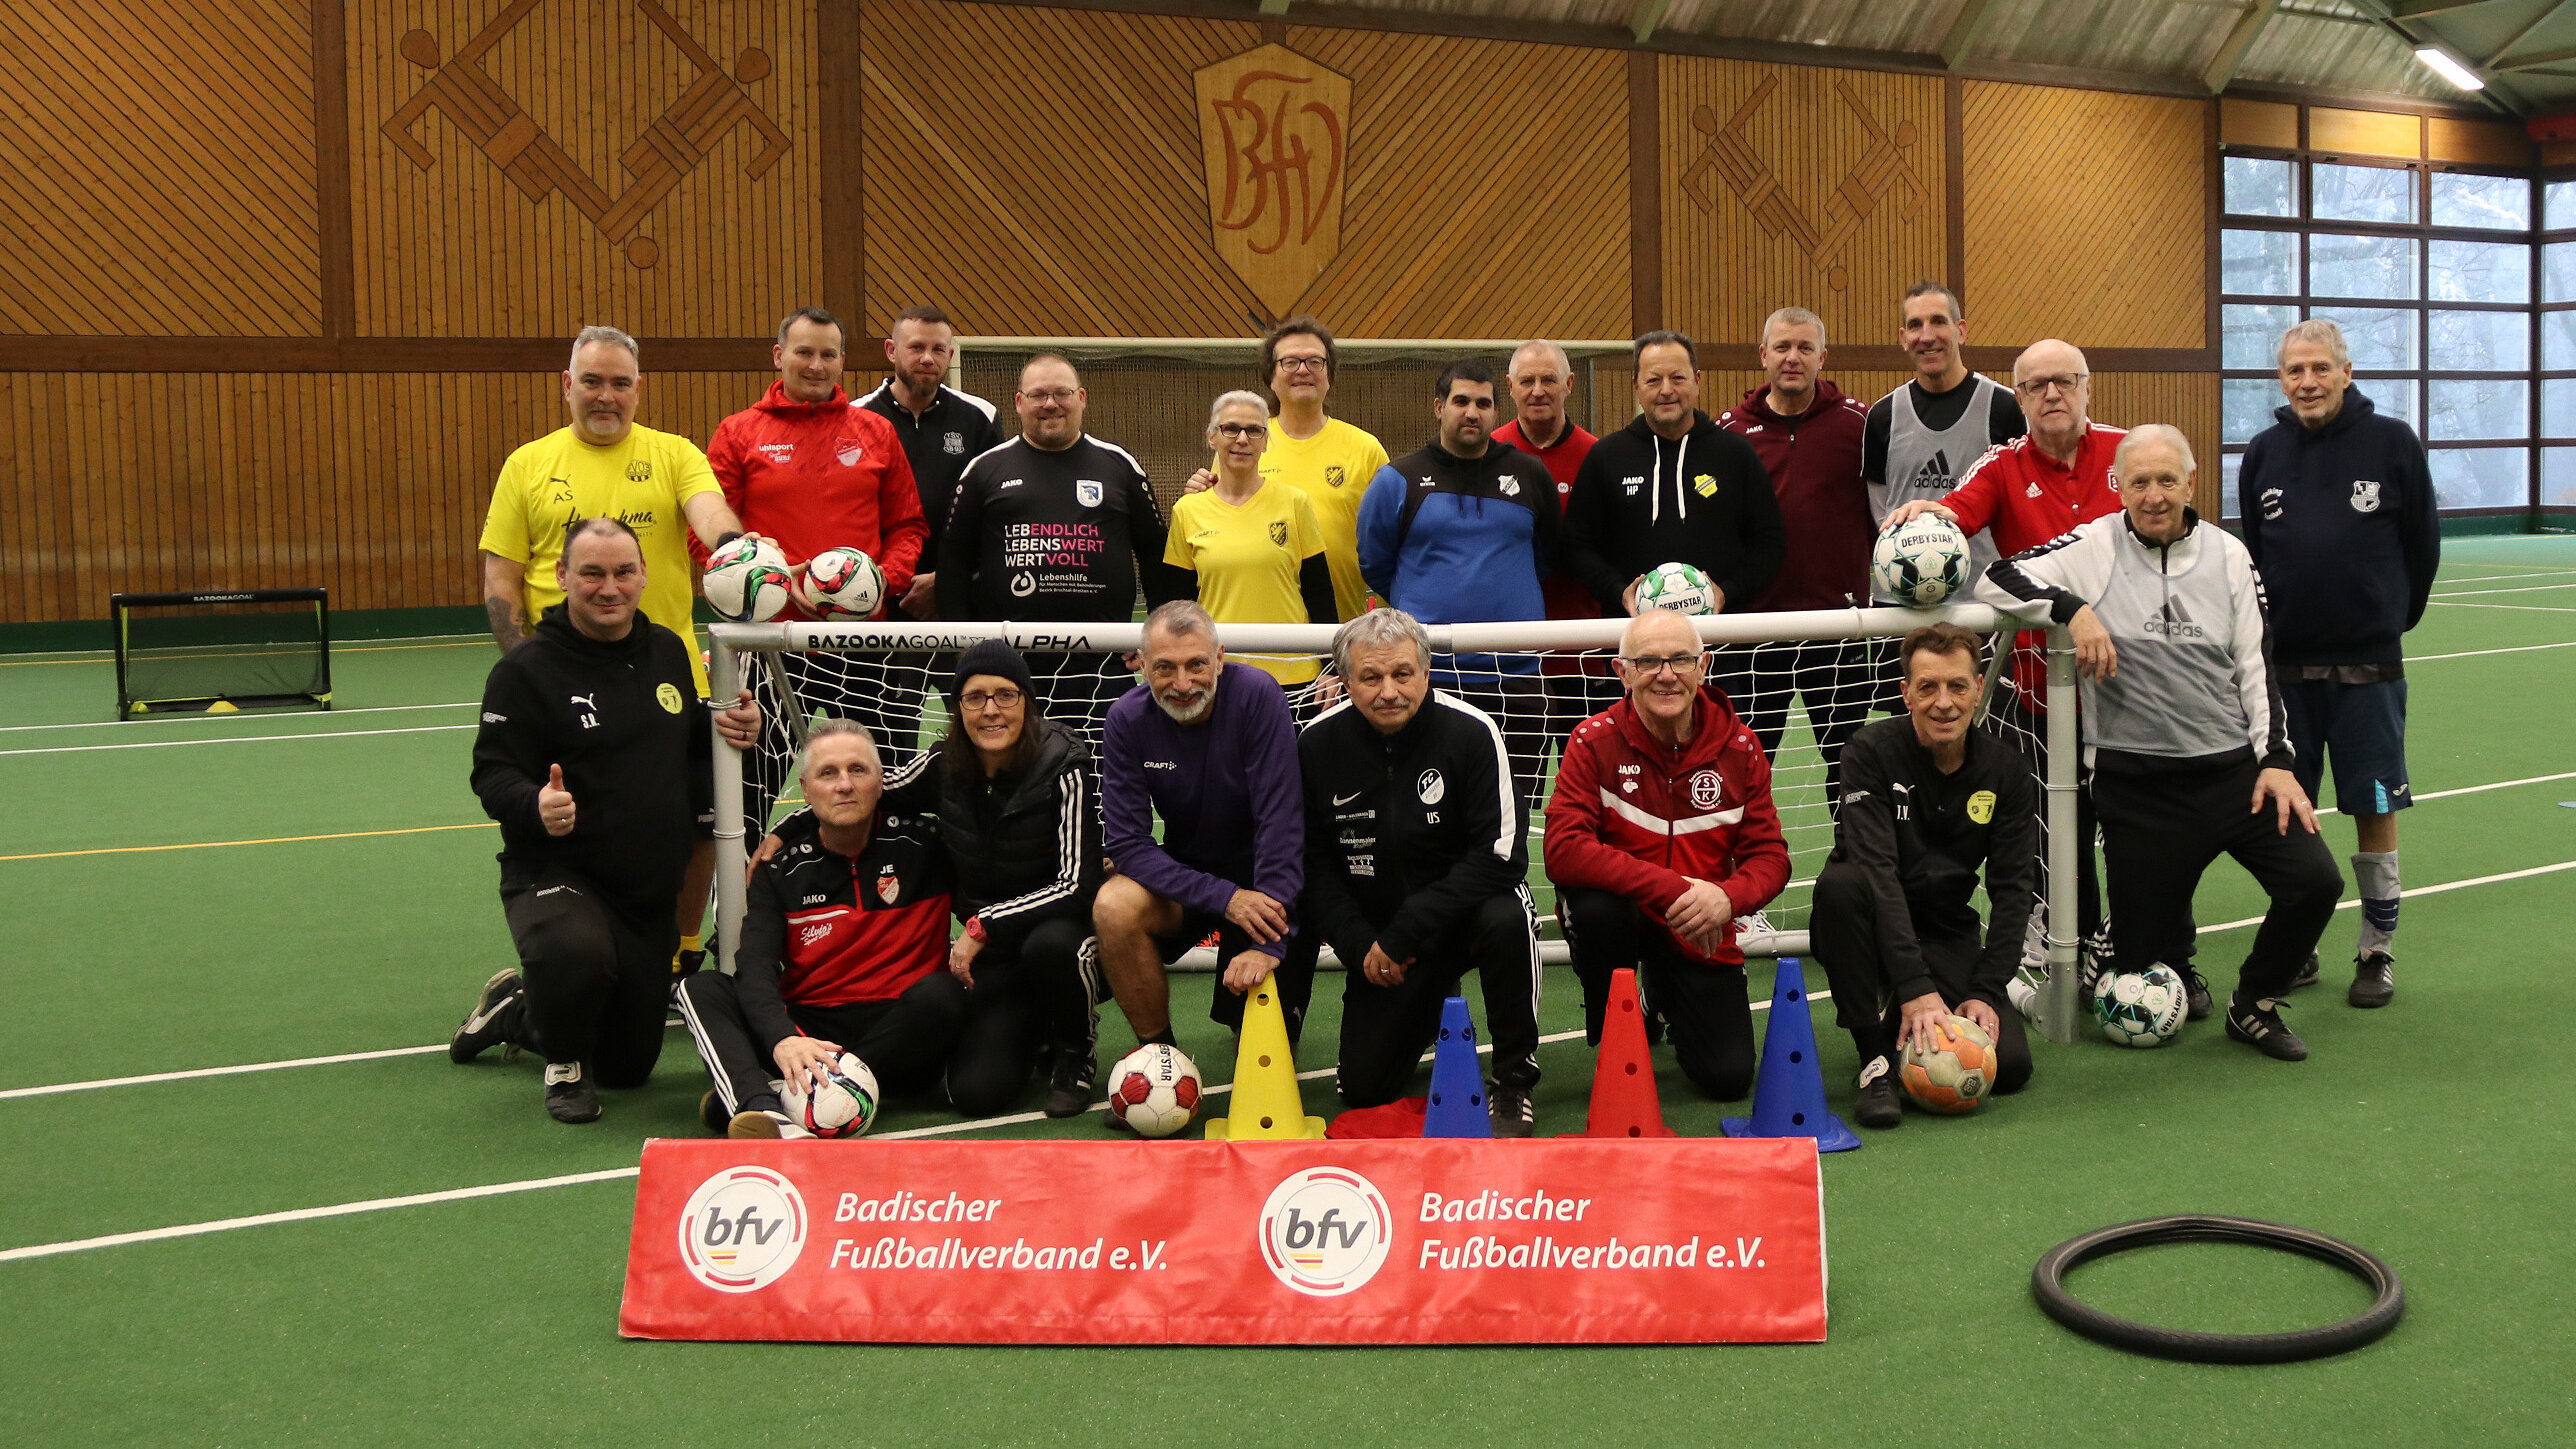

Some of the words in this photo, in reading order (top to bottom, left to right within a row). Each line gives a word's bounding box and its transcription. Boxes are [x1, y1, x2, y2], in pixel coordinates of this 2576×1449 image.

[1746, 425, 1763, 434] JAKO
[758, 443, 794, 452] uhlsport
[1001, 479, 1023, 489] JAKO
[1622, 476, 1644, 485] JAKO
[1914, 473, 1957, 490] adidas
[553, 490, 573, 504] AS
[1626, 485, 1639, 496] HP
[1004, 523, 1099, 538] LEBENDLICH
[1004, 538, 1105, 552] LEBENSWERT
[1901, 533, 1954, 548] DERBYSTAR
[1004, 553, 1089, 567] WERTVOLL
[1039, 572, 1088, 582] Lebenshilfe
[2143, 621, 2203, 638] adidas
[580, 712, 600, 729] S.R.
[1143, 761, 1169, 769] CRAFT
[1618, 764, 1641, 775] JAKO
[1426, 811, 1441, 824] US
[880, 864, 895, 874] JE
[802, 894, 827, 905] JAKO
[800, 922, 833, 941] Silvio's
[834, 1191, 1002, 1223] Badischer
[1419, 1189, 1592, 1222] Badischer
[703, 1205, 784, 1246] bfv
[1285, 1208, 1368, 1249] bfv
[829, 1236, 1103, 1270] Fußballverband
[1109, 1240, 1169, 1271] e.V.
[1418, 1235, 1699, 1270] Fußballverband
[1705, 1236, 1766, 1269] e.V.
